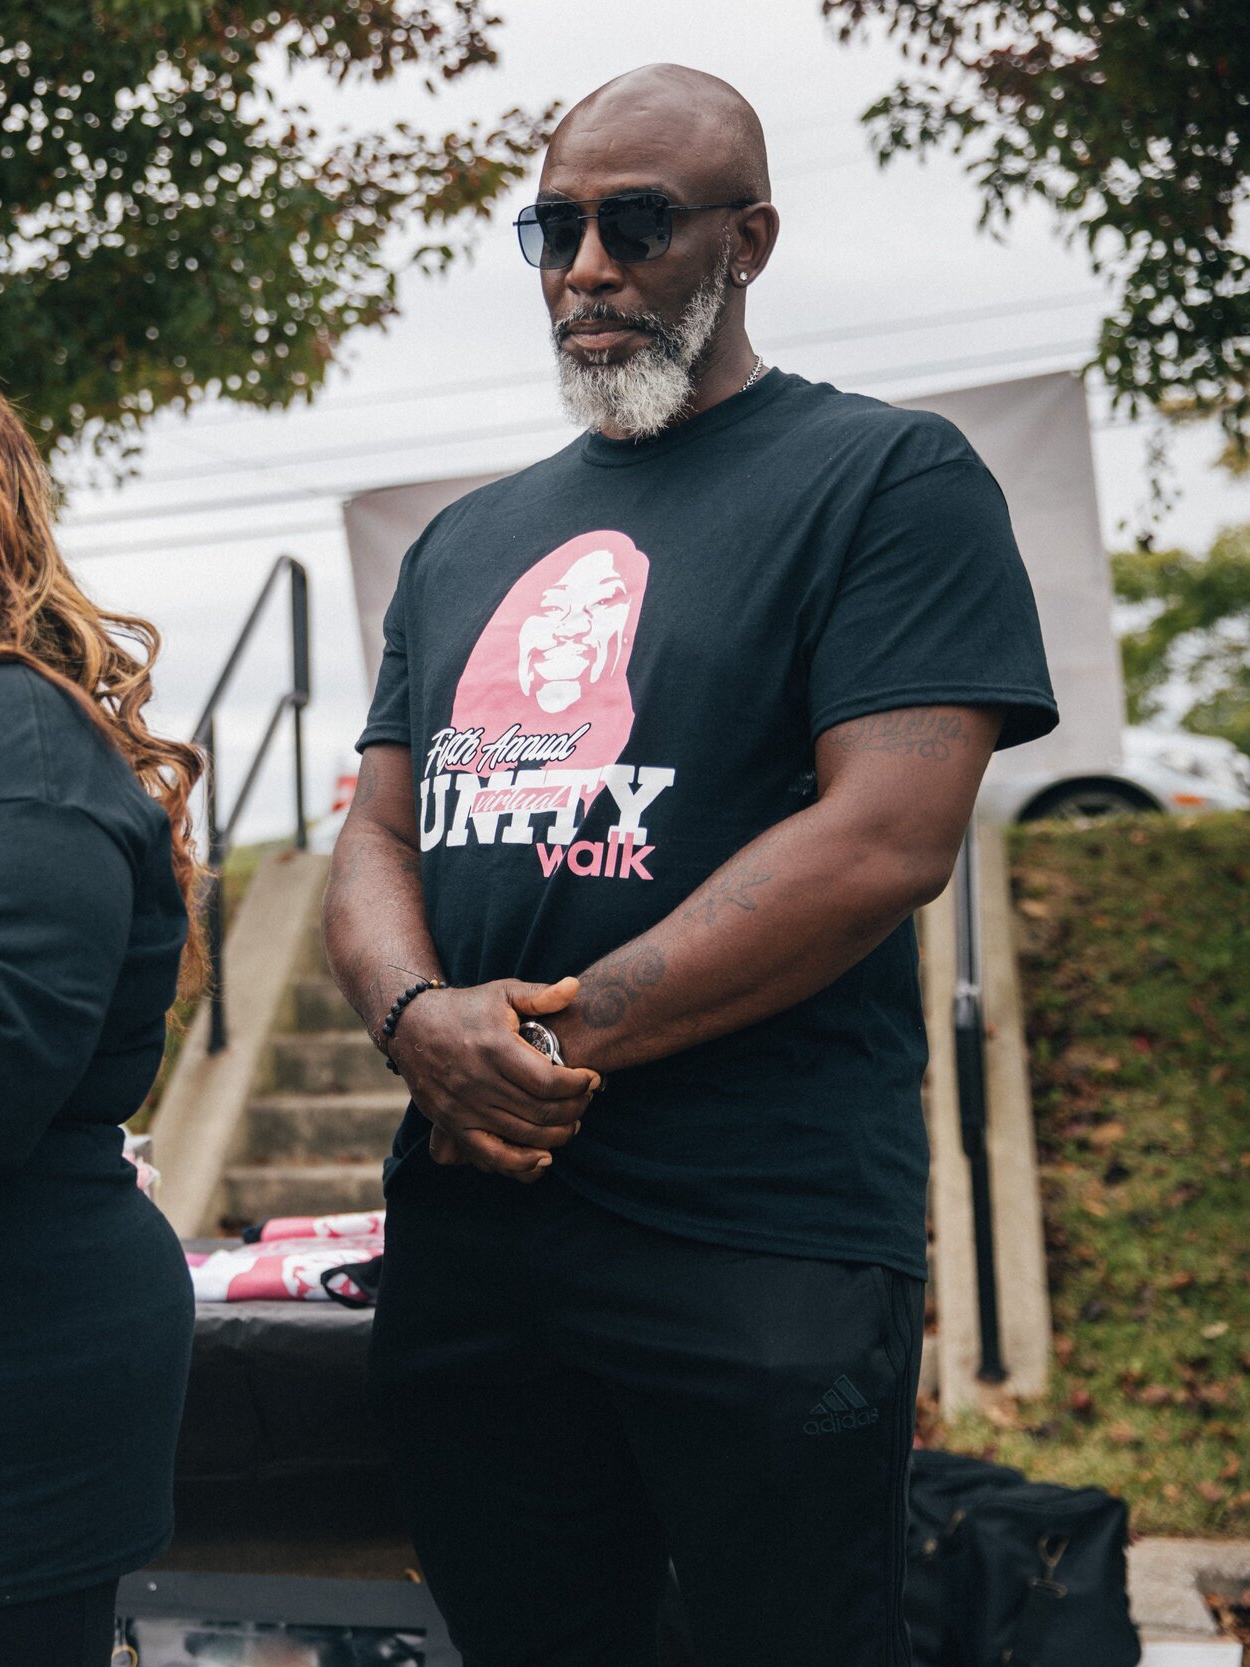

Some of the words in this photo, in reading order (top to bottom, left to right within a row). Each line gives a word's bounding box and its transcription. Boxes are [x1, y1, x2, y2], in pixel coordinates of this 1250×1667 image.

[476, 723, 591, 772] Annual
[420, 764, 675, 852] UNITY
[474, 789, 569, 814] virtual
[536, 831, 656, 881] walk
[803, 1407, 879, 1435] adidas
